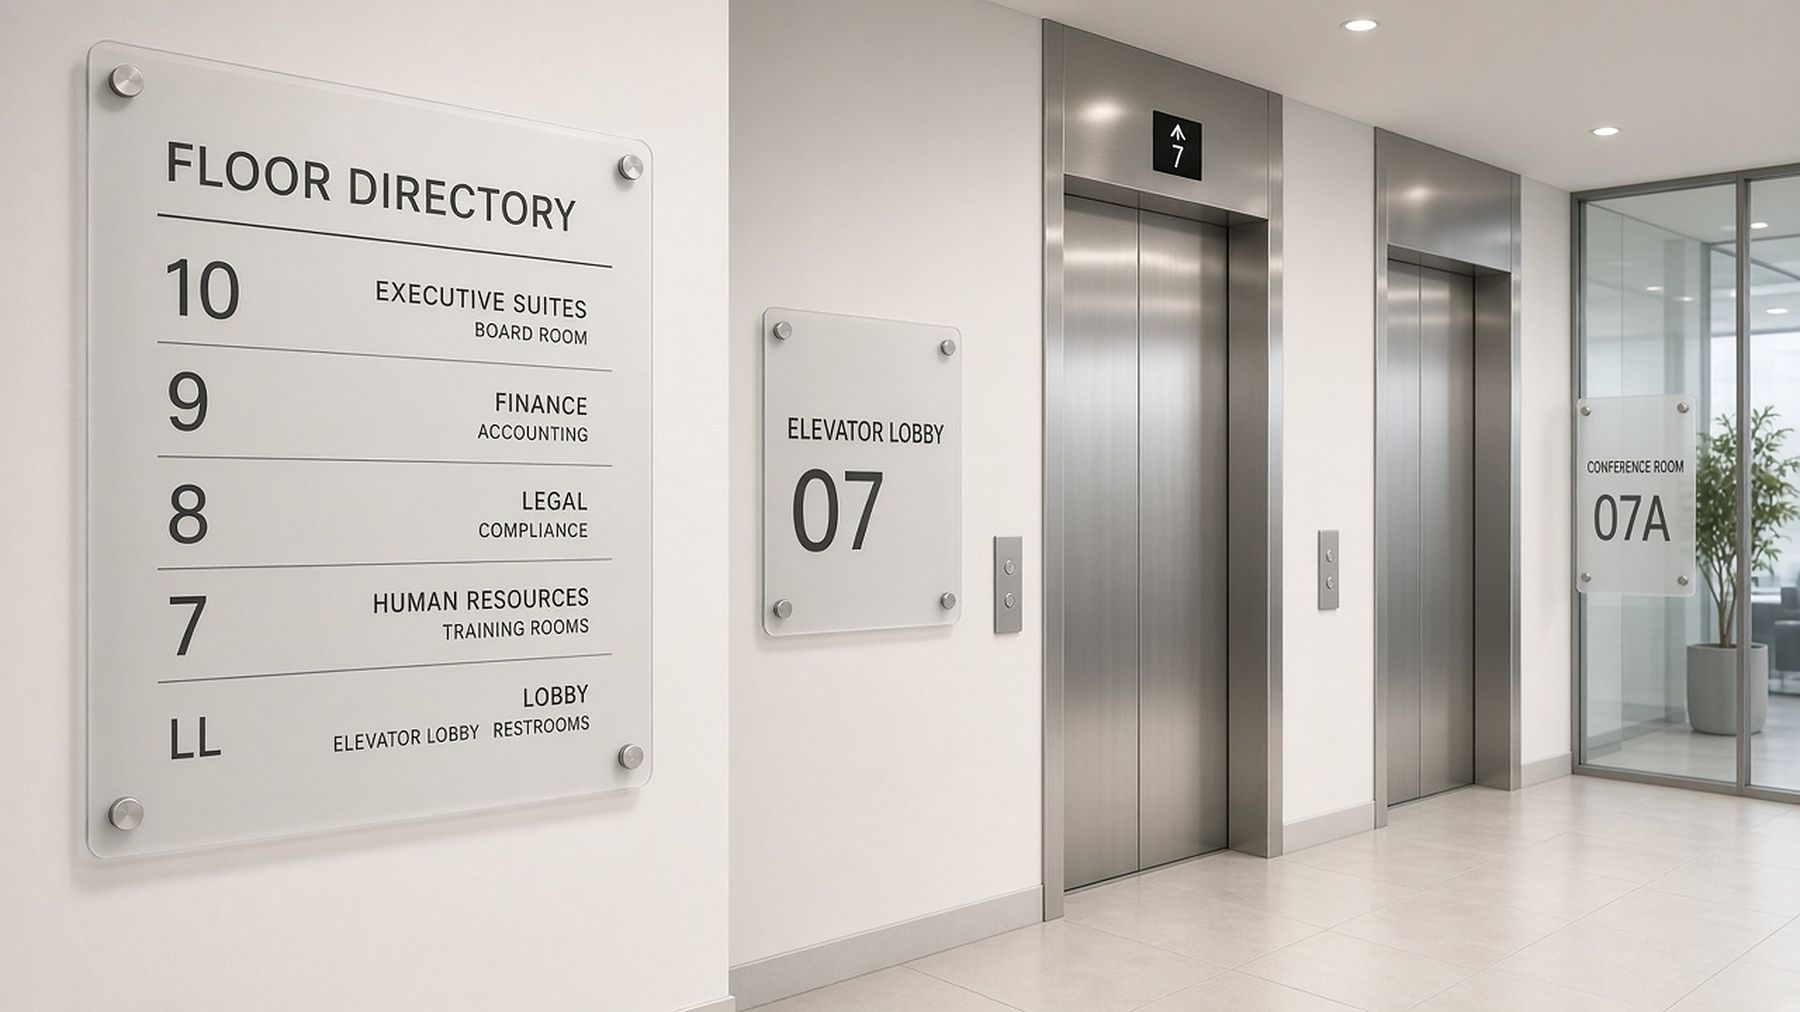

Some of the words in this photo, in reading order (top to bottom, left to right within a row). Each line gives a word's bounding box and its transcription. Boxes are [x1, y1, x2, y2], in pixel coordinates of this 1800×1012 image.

[1172, 144, 1183, 168] 7
[168, 140, 330, 201] FLOOR
[349, 167, 576, 231] DIRECTORY
[167, 258, 239, 319] 10
[376, 280, 504, 311] EXECUTIVE
[513, 293, 586, 318] SUITES
[475, 321, 532, 340] BOARD
[539, 326, 587, 345] ROOM
[168, 371, 207, 431] 9
[495, 392, 587, 415] FINANCE
[477, 423, 587, 442] ACCOUNTING
[788, 417, 883, 442] ELEVATOR
[889, 421, 944, 444] LOBBY
[1587, 460, 1650, 473] CONFERENCE
[1653, 459, 1683, 473] ROOM
[168, 483, 207, 544] 8
[522, 490, 587, 510] LEGAL
[792, 468, 883, 552] 07
[478, 522, 587, 537] COMPLIANCE
[1594, 494, 1670, 541] 07A
[373, 590, 457, 613] HUMAN
[467, 587, 588, 610] RESOURCES
[169, 595, 206, 655] 7
[442, 620, 524, 640] TRAINING
[530, 617, 588, 635] ROOMS
[523, 684, 588, 707] LOBBY
[170, 716, 221, 759] LL
[333, 728, 420, 752] ELEVATOR
[427, 724, 479, 743] LOBBY
[493, 714, 589, 738] RESTROOMS
